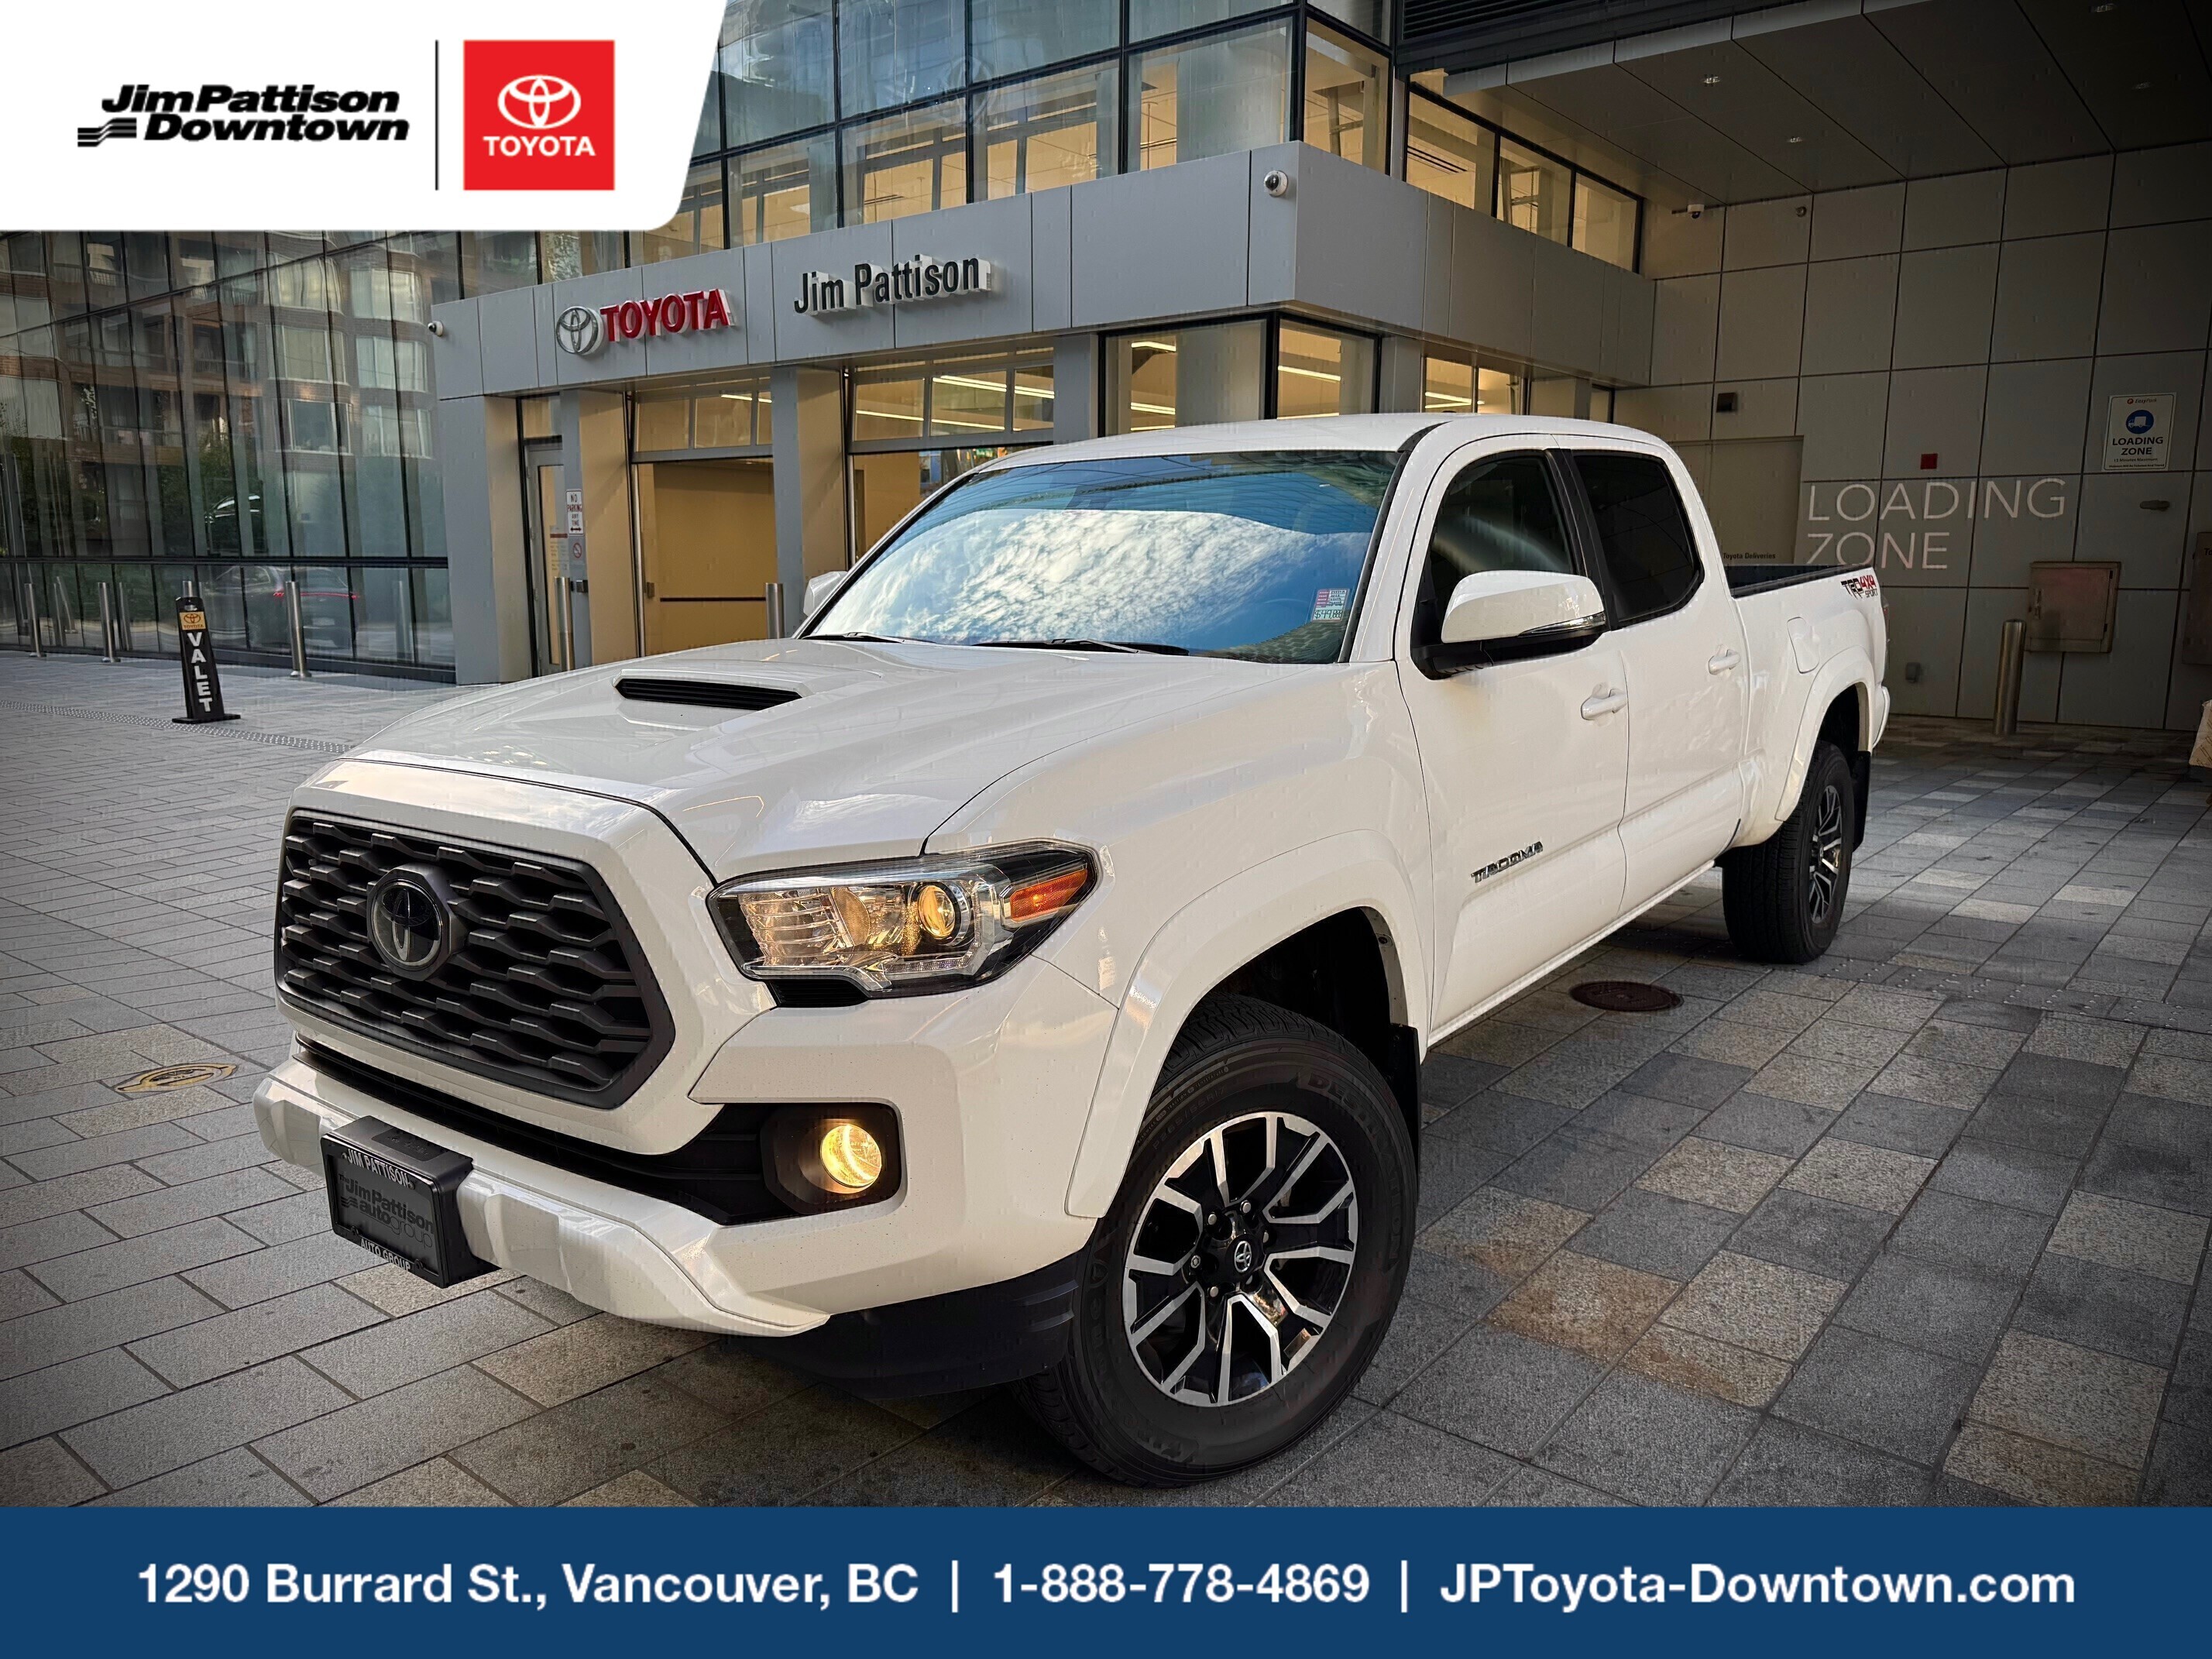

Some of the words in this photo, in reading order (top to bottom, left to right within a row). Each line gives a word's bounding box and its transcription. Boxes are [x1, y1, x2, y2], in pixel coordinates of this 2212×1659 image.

[794, 271, 845, 314] Jim
[854, 254, 984, 306] Pattison
[599, 288, 732, 342] TOYOTA
[2112, 437, 2163, 445] LOADING
[570, 493, 578, 503] NO
[1808, 478, 2066, 521] LOADING
[1807, 532, 1950, 569] ZONE
[1841, 578, 1863, 599] TRD
[187, 632, 213, 713] VALET
[1471, 841, 1543, 883] TACOMA
[347, 1149, 364, 1168] JIM
[366, 1156, 409, 1187] PATTISON
[360, 1238, 381, 1257] AUTO
[383, 1249, 411, 1271] GROUP
